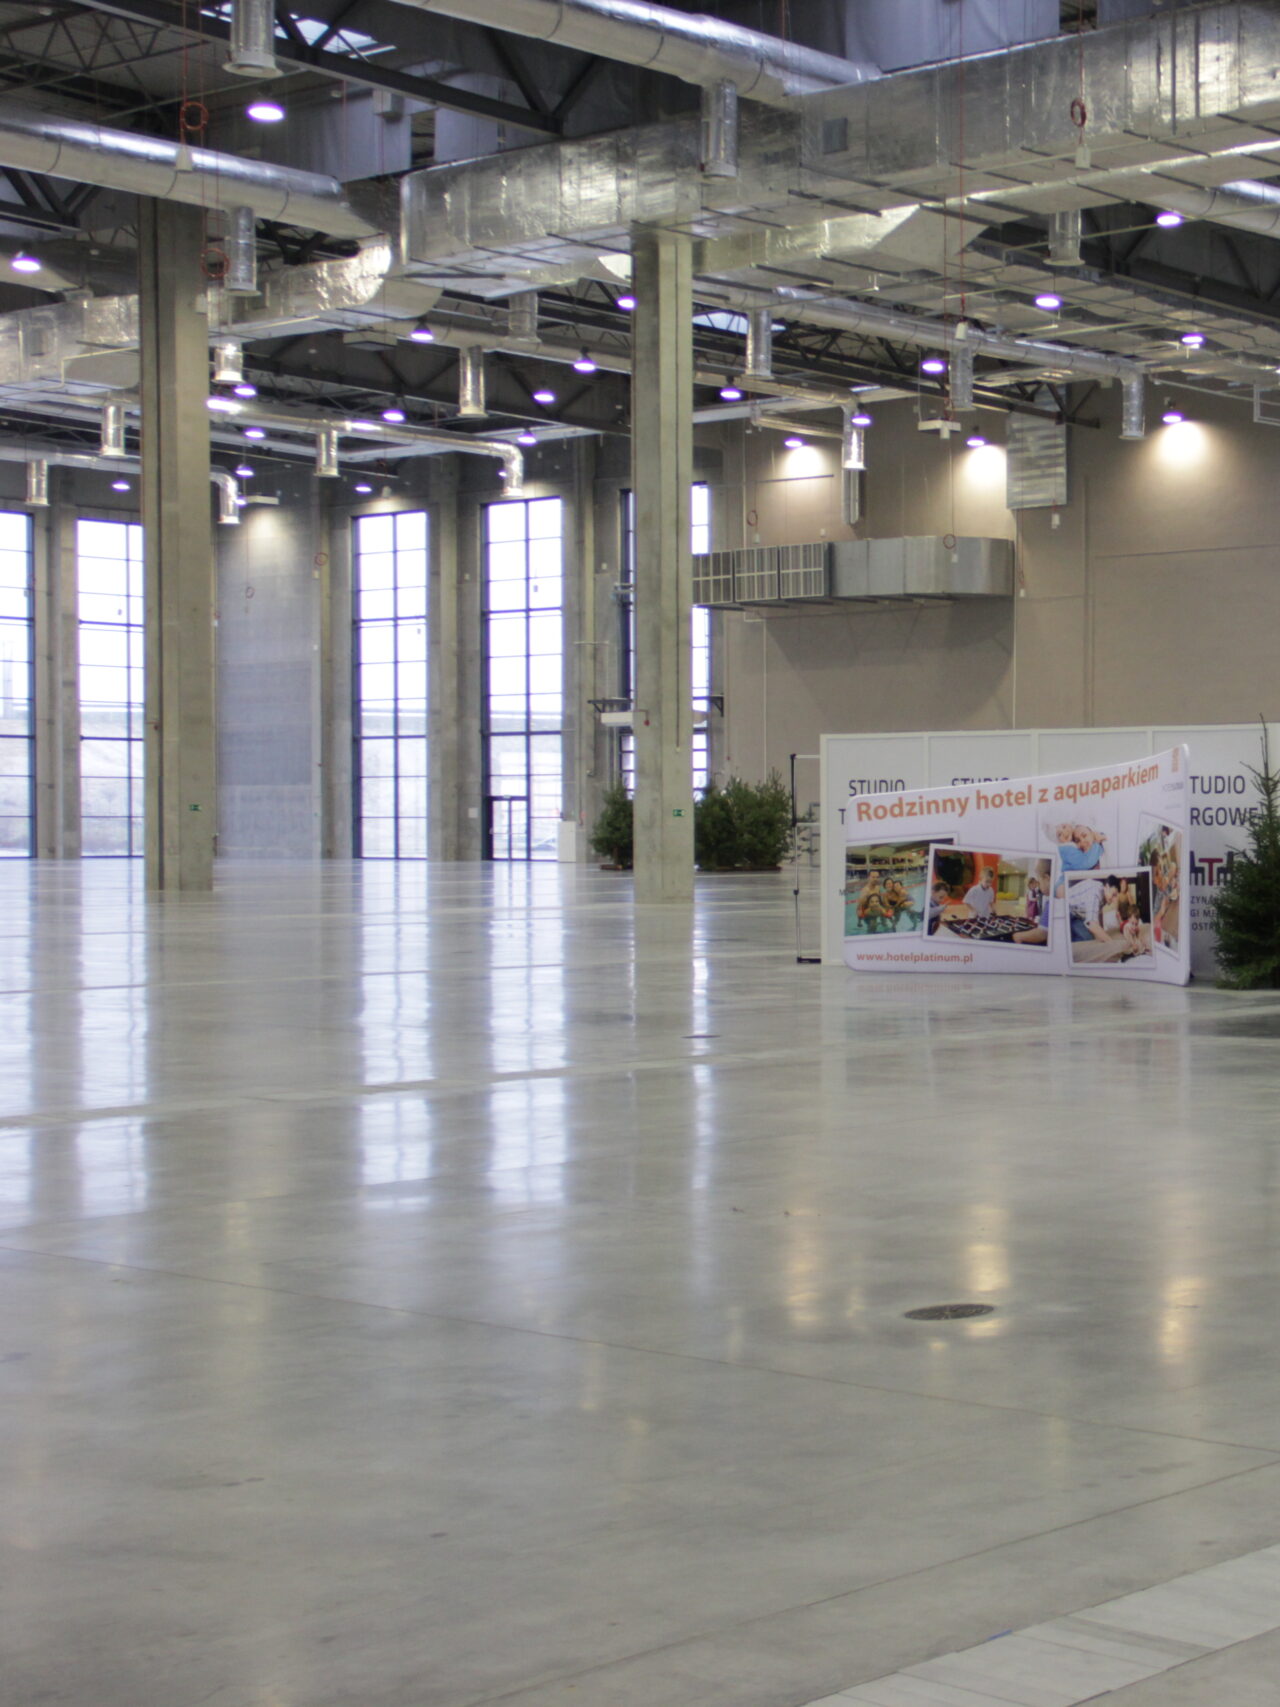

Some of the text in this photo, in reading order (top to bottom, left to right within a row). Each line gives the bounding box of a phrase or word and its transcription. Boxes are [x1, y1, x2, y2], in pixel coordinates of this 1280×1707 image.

[856, 795, 970, 822] Rodzinny
[975, 784, 1033, 810] hotel
[1038, 787, 1049, 803] z
[1053, 763, 1159, 804] aquaparkiem
[1189, 775, 1246, 794] TUDIO
[856, 952, 974, 964] www.hotelplatinum.pl
